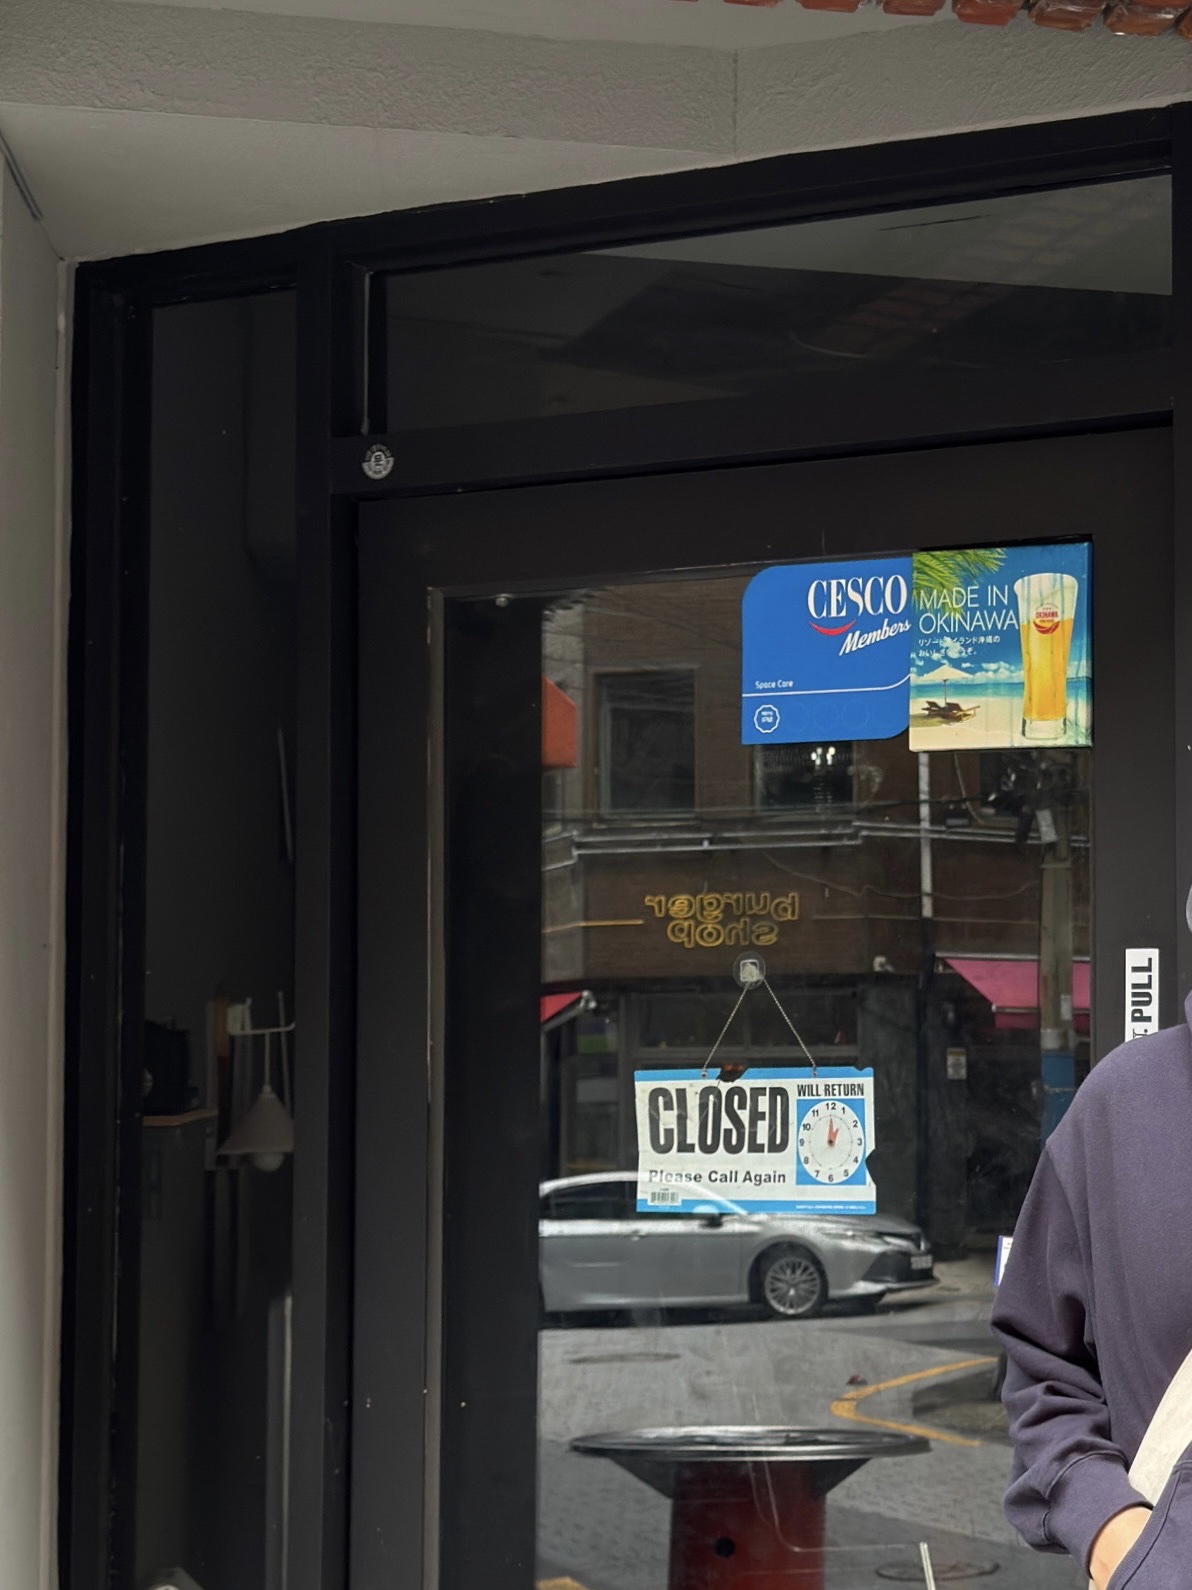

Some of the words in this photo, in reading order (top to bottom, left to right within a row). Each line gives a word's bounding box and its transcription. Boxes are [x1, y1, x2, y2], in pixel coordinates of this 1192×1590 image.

[807, 574, 908, 620] CESCO
[919, 586, 980, 610] MADE
[987, 585, 1009, 607] IN
[919, 609, 1019, 634] OKINAWA
[839, 618, 912, 656] Members
[755, 680, 776, 689] Space
[777, 680, 794, 688] Care
[1130, 957, 1152, 1023] PULL
[797, 1083, 821, 1097] WILL
[824, 1083, 864, 1097] RETURN
[825, 1102, 836, 1111] 12
[841, 1107, 846, 1115] 1
[811, 1109, 819, 1117] 11
[648, 1086, 790, 1154] CLOSED
[852, 1120, 858, 1128] 2
[802, 1123, 811, 1131] 10
[799, 1138, 805, 1147] 9
[857, 1138, 863, 1146] 3
[803, 1156, 809, 1165] 8
[853, 1156, 859, 1164] 4
[649, 1169, 702, 1183] Please
[708, 1169, 738, 1183] Call
[743, 1170, 787, 1186] Again
[814, 1170, 820, 1178] 7
[828, 1174, 834, 1182] 6
[843, 1169, 849, 1178] 5
